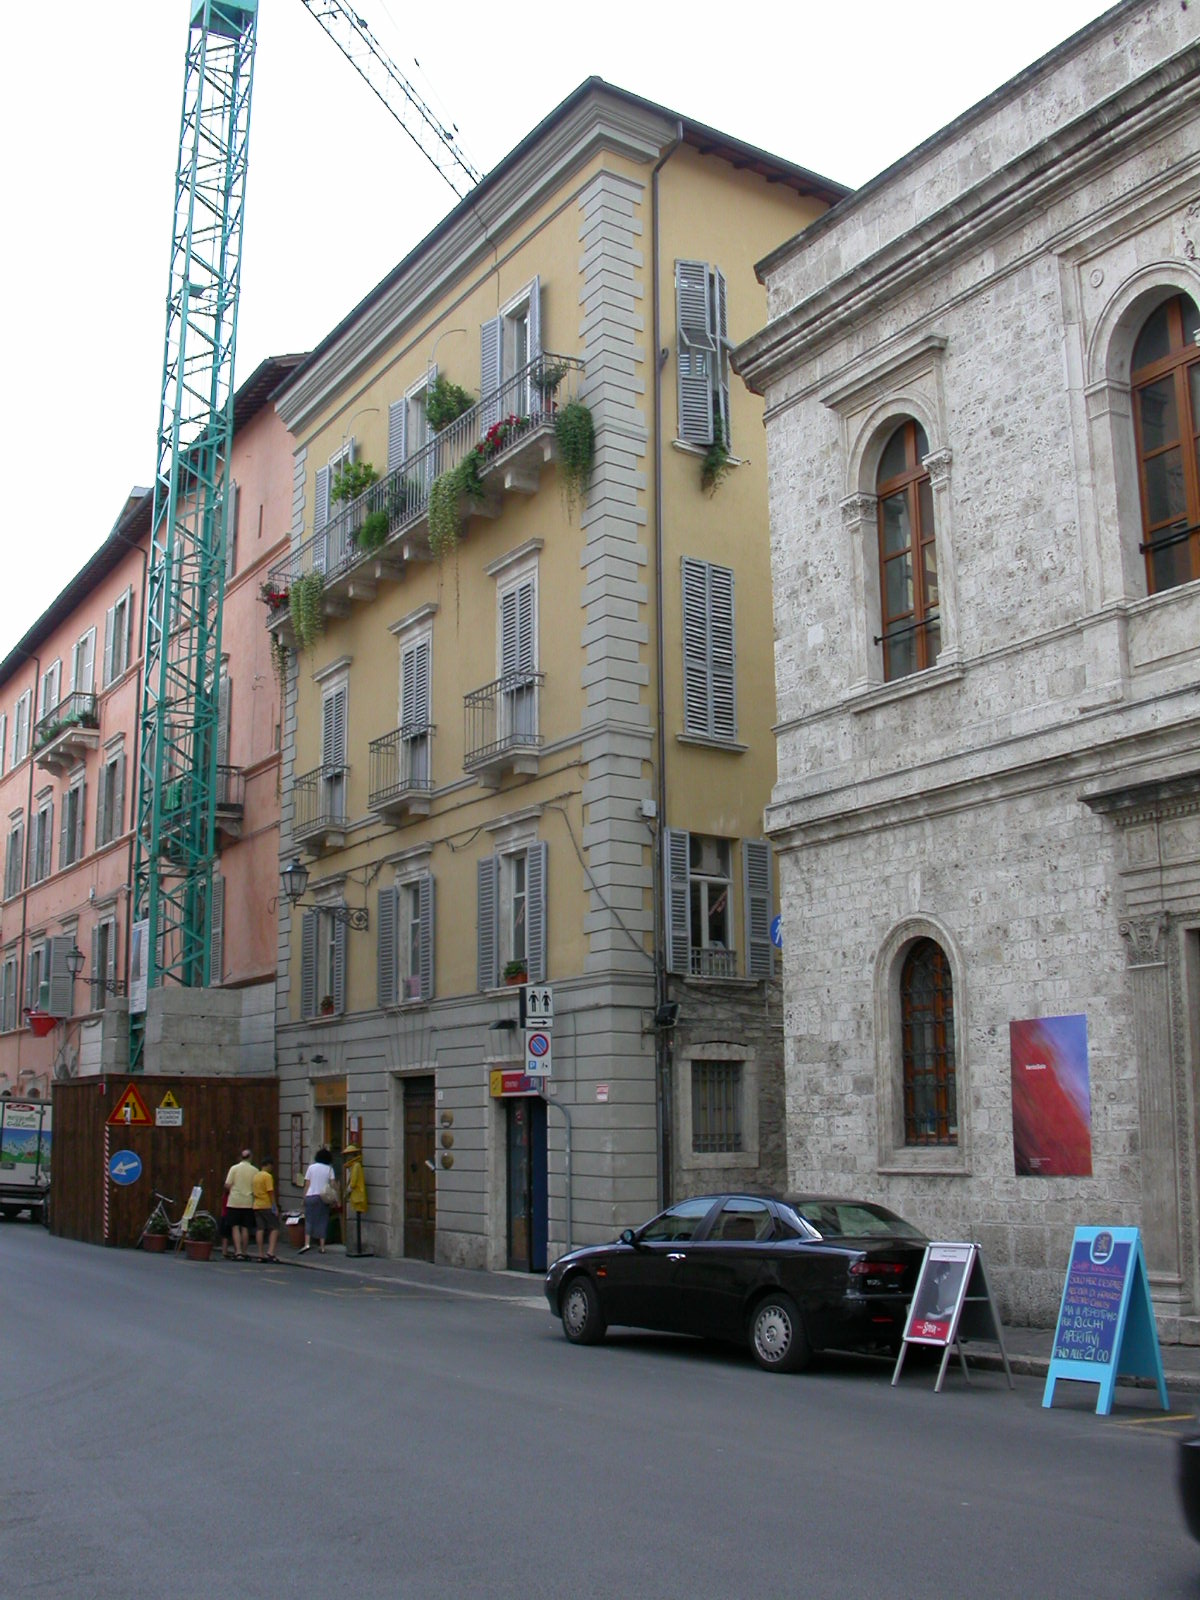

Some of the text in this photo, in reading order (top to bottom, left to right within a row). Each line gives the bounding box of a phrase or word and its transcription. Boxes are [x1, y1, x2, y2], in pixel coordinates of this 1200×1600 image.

[1073, 1315, 1104, 1330] RICCHI
[1062, 1329, 1100, 1348] APERITIVI
[1055, 1345, 1069, 1358] FINO
[1069, 1348, 1085, 1359] ALLE
[1084, 1345, 1096, 1361] 21
